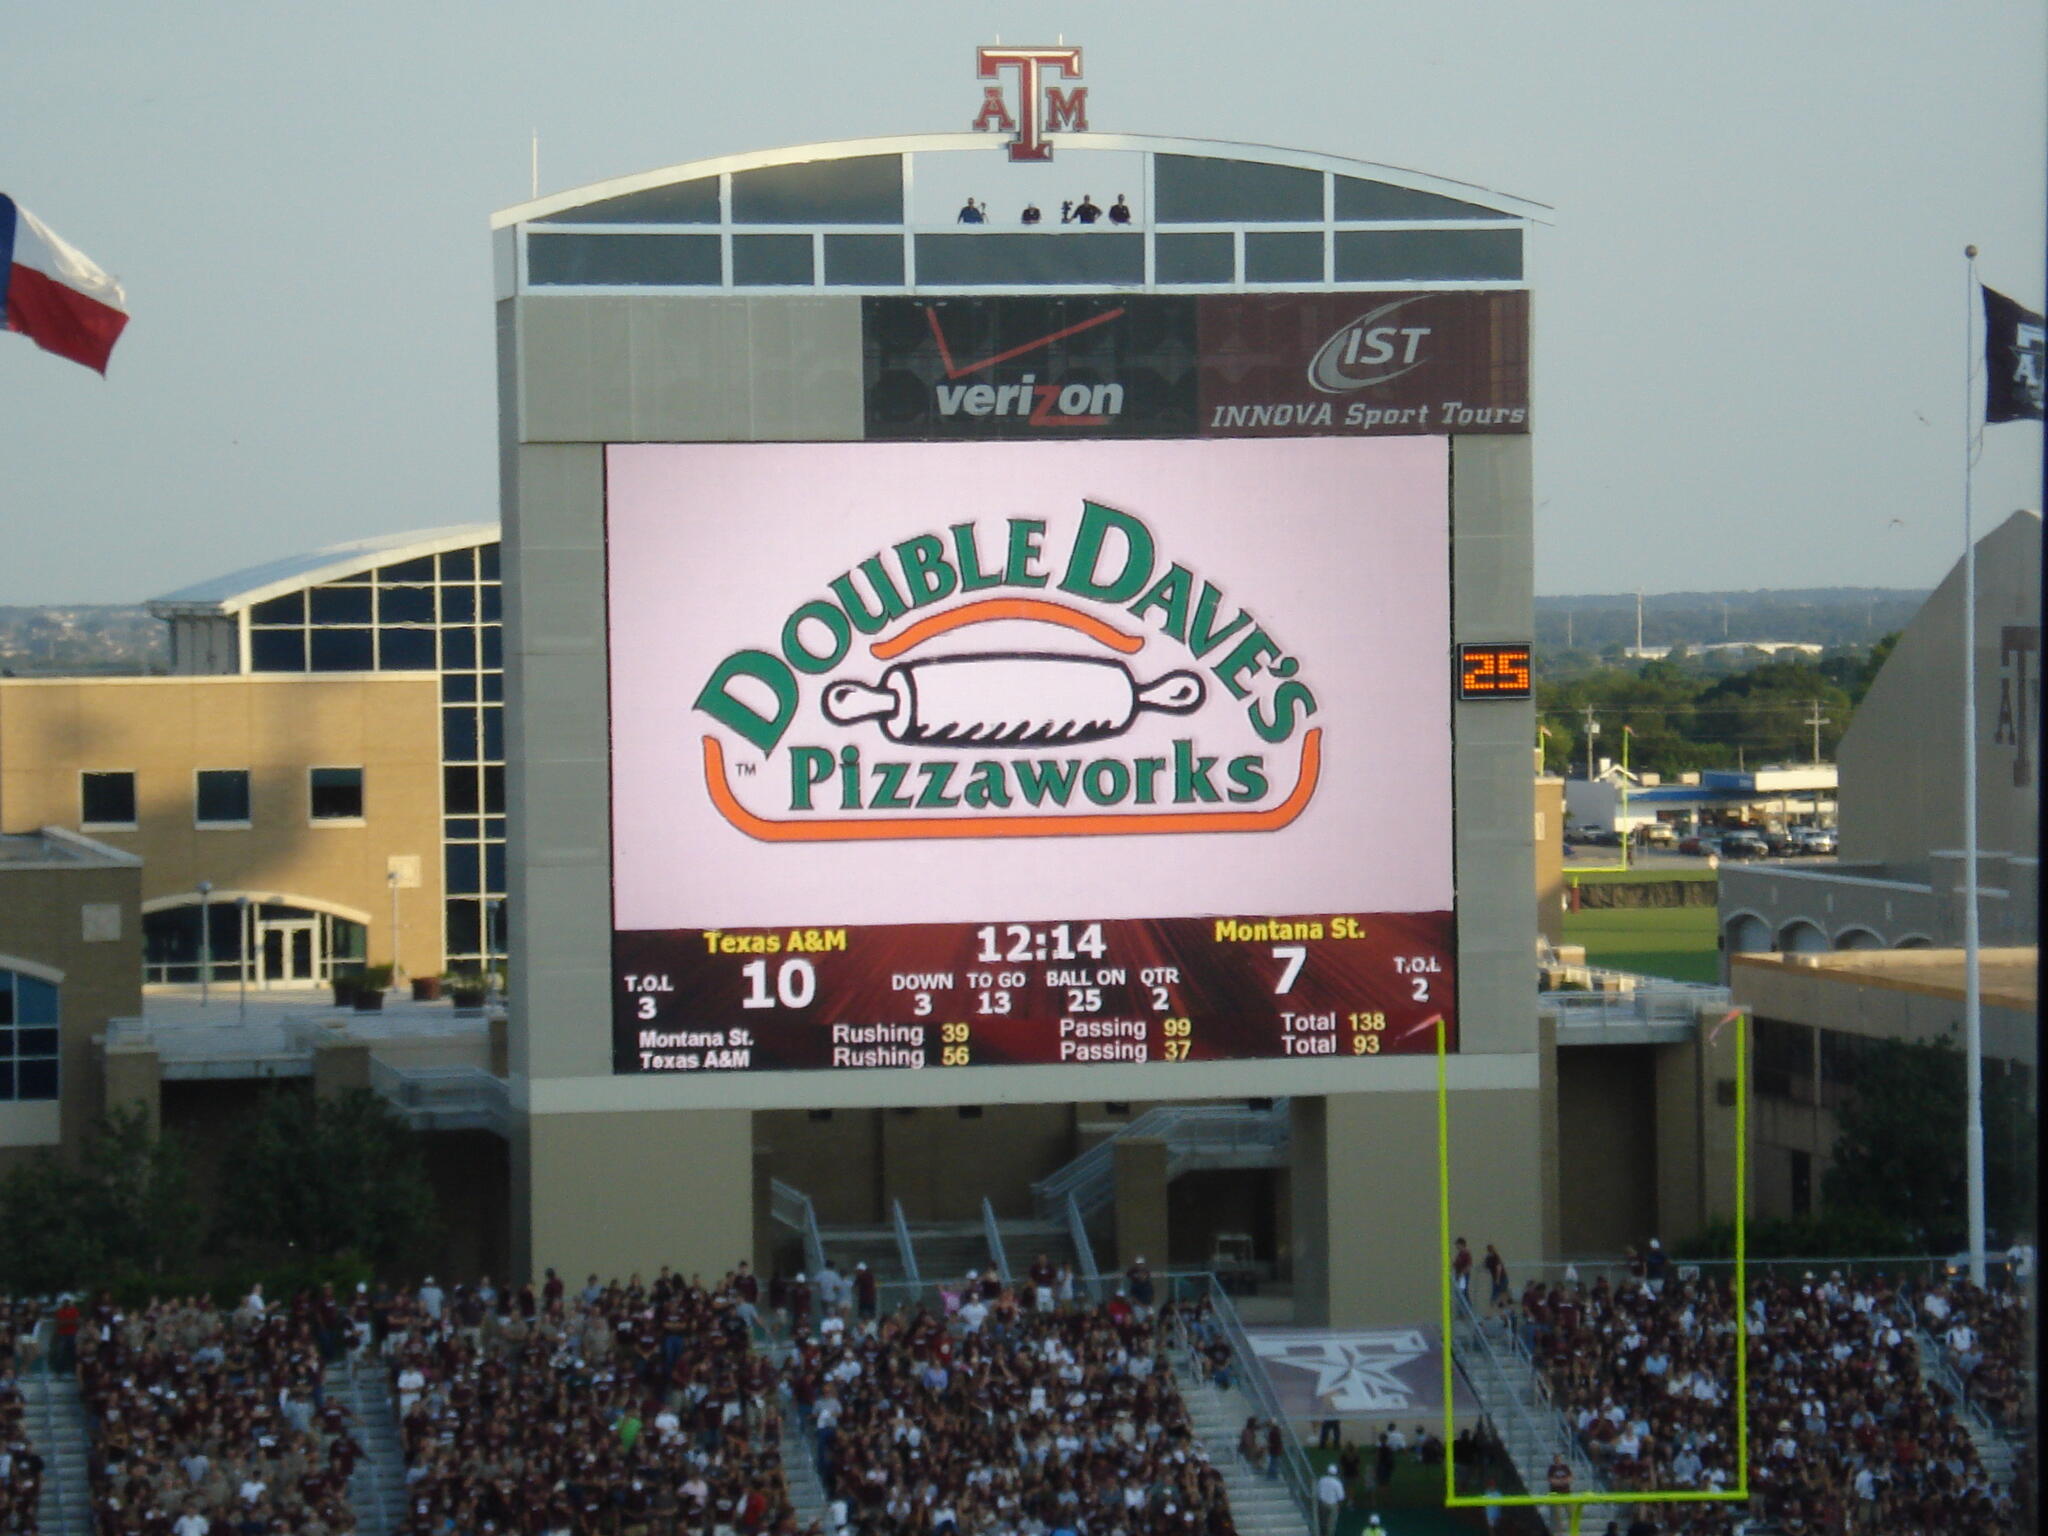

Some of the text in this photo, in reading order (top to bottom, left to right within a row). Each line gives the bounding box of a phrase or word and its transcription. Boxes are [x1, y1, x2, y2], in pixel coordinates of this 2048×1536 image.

[1344, 326, 1431, 365] IST
[935, 373, 1124, 426] verizon
[1211, 400, 1525, 430] INNOVA Sport Tours
[693, 518, 1050, 759] DOUBLE
[1464, 653, 1528, 689] 25
[735, 763, 756, 777] TM
[788, 738, 1269, 811] Pizzaworks
[1214, 917, 1366, 942] Montana St.
[704, 929, 847, 954] Texas A&M
[976, 923, 1107, 963] 12:14
[891, 973, 953, 991] DOWN
[966, 972, 1026, 989] TO GO
[1046, 969, 1126, 988] BALL ON
[1140, 968, 1179, 987] QTR
[1272, 946, 1307, 995] 7
[741, 958, 817, 1010] 10
[1412, 978, 1430, 1002] 2
[637, 998, 657, 1021] 3
[913, 995, 933, 1017] 3
[976, 992, 1012, 1015] 13
[1067, 989, 1102, 1013] 25
[1151, 988, 1169, 1011] 2
[1060, 1018, 1191, 1041] Passing 99
[1281, 1012, 1386, 1032] Total 138
[638, 1028, 755, 1050] Montana St.
[832, 1023, 970, 1046] Rushing 39
[1281, 1034, 1381, 1055] Total 93
[640, 1051, 751, 1069] Texas A&M
[832, 1046, 970, 1069] Rushing 56
[1060, 1041, 1192, 1064] Passing 37
